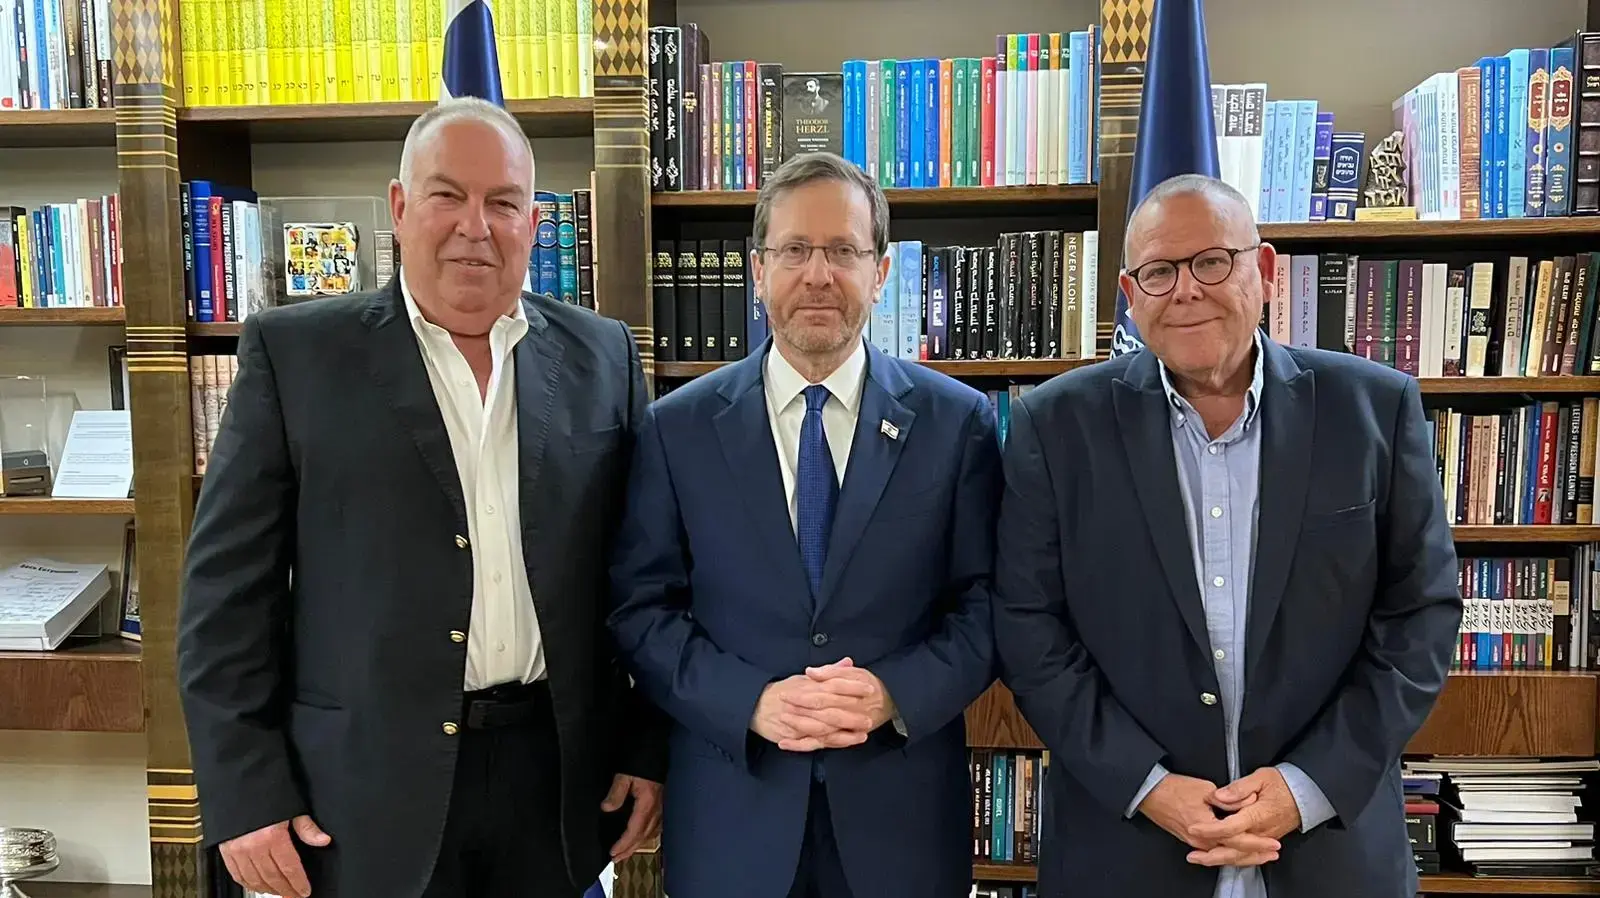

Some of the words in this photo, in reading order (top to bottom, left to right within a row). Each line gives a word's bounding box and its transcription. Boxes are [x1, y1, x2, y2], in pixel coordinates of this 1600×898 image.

[766, 97, 772, 108] AM
[665, 107, 676, 141] ישראל
[796, 126, 829, 134] HERZL
[222, 211, 231, 235] LETTERS
[224, 242, 232, 273] PRESIDENT
[1068, 237, 1077, 272] NEVER
[225, 275, 234, 299] CLINTON
[934, 289, 944, 300] בן
[1068, 276, 1077, 311] ALONE
[933, 302, 944, 326] גוריון
[1508, 297, 1518, 313] דרך
[1573, 292, 1583, 316] מלחמת
[1507, 316, 1516, 337] חיים
[1571, 409, 1580, 434] LETTERS
[1569, 441, 1579, 474] PRESIDENT
[1567, 475, 1577, 501] CLINTON
